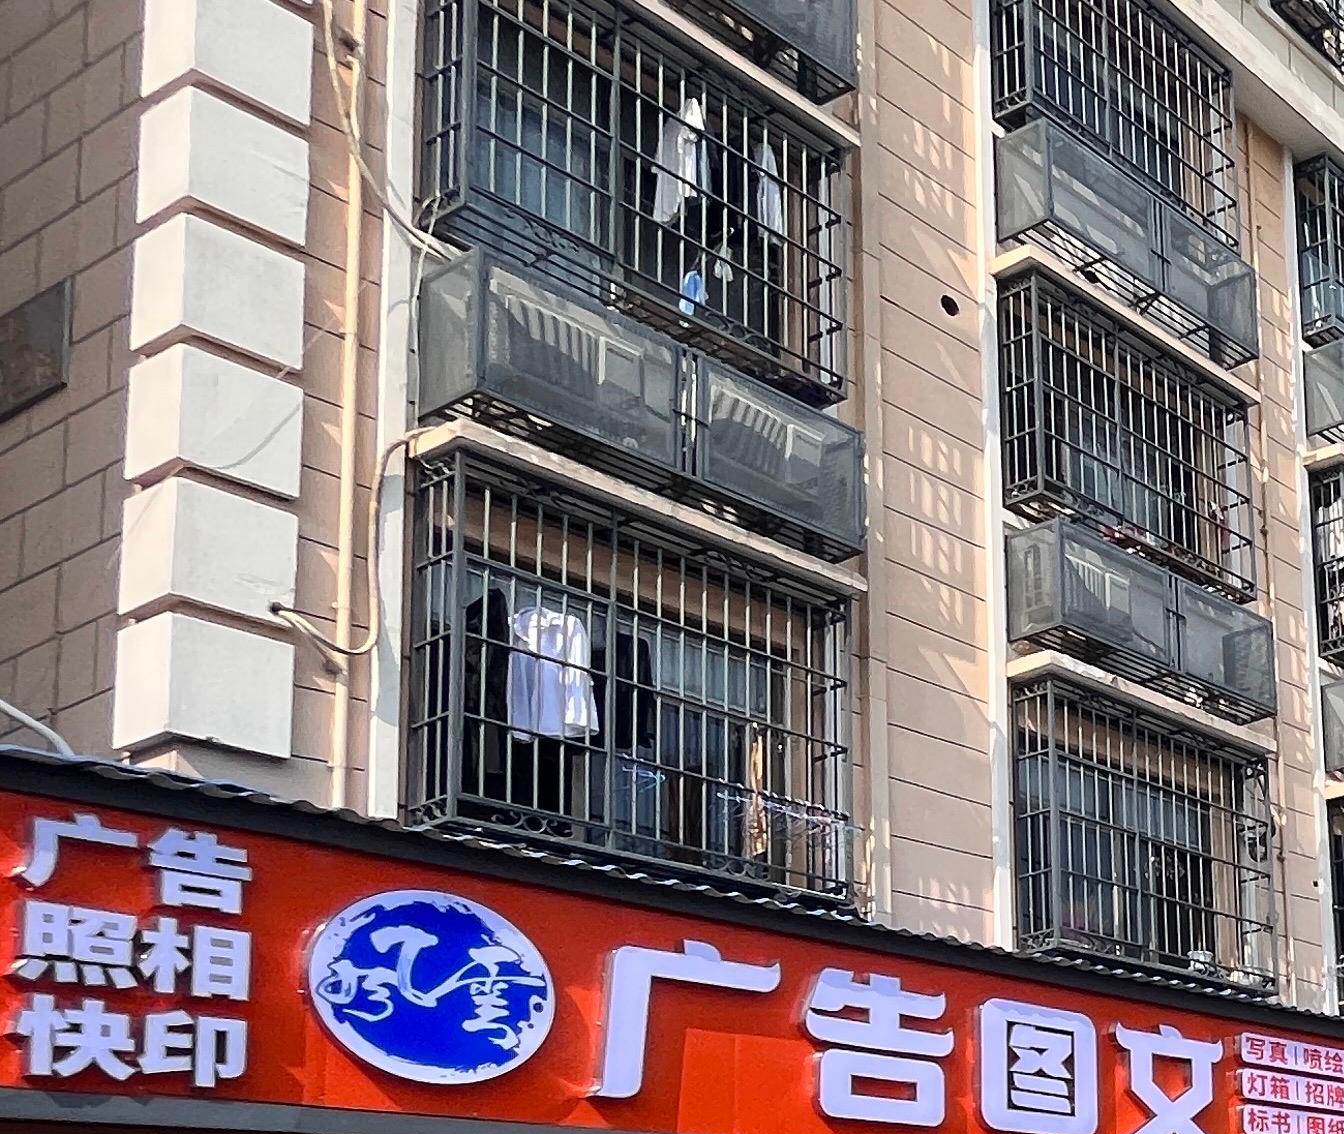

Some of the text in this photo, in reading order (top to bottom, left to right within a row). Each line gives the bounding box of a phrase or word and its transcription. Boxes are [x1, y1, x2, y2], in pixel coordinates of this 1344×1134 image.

[15, 812, 253, 915] 广告
[14, 899, 253, 1001] 照相
[15, 993, 249, 1088] 快印
